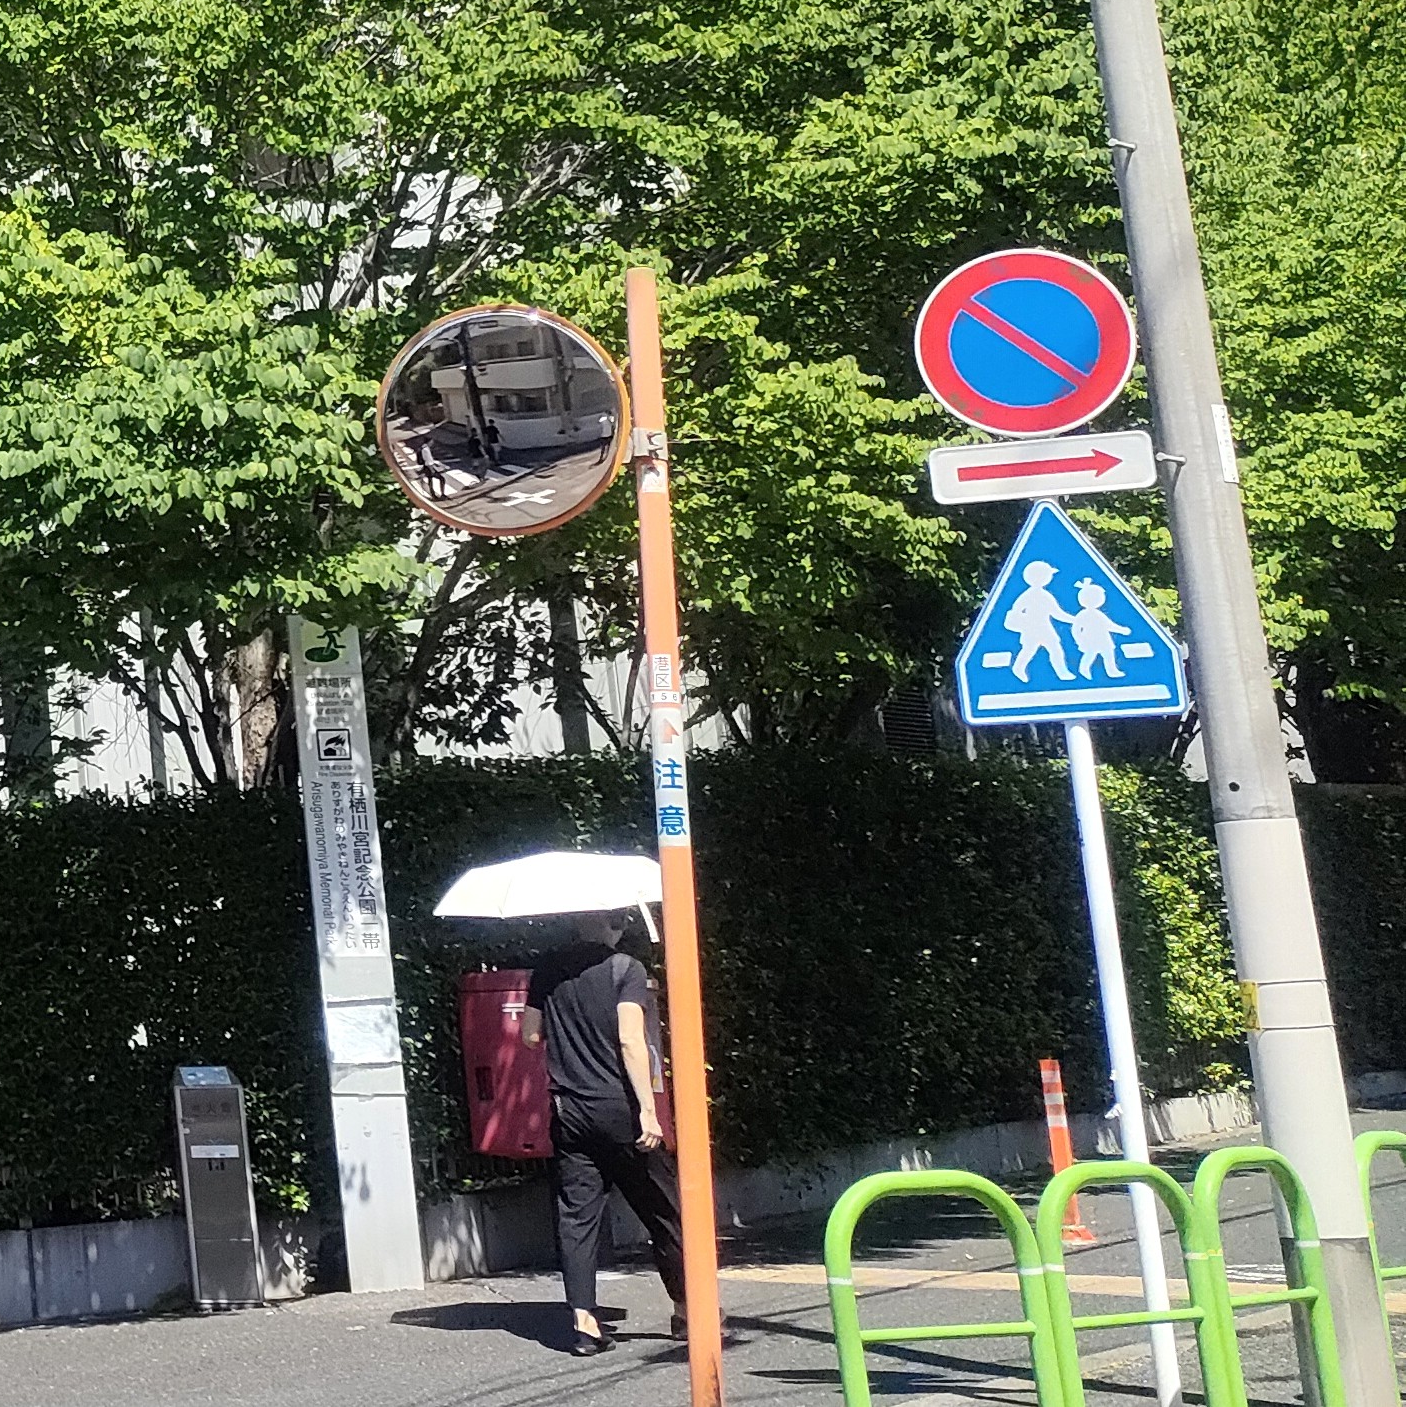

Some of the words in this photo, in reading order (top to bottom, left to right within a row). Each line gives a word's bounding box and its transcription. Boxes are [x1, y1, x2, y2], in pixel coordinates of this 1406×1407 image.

[654, 657, 670, 687] 港区
[309, 781, 330, 870] Arisugawanomiya
[654, 757, 687, 836] 注意
[319, 872, 335, 919] Memorial
[346, 781, 380, 949] 有栖川宮記念公園一帯
[324, 922, 338, 946] Park
